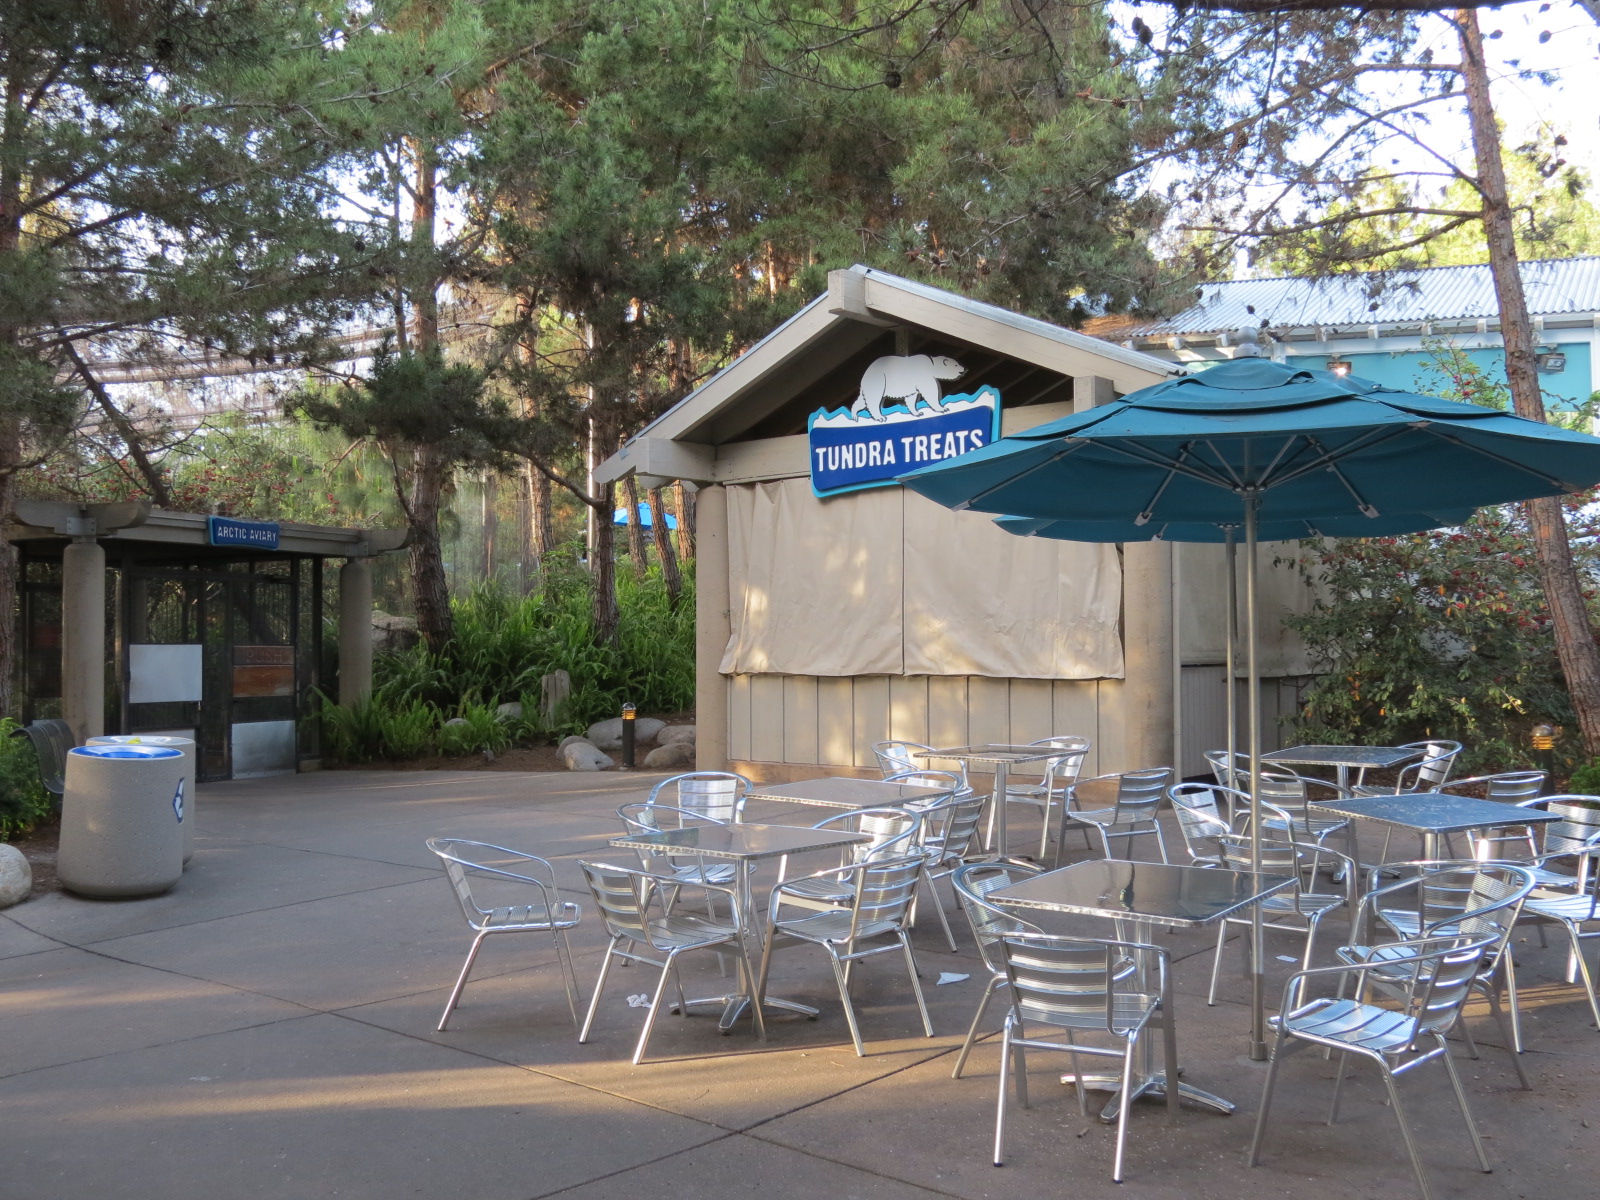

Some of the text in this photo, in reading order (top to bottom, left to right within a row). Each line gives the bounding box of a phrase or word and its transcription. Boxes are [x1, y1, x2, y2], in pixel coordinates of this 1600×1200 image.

[815, 429, 983, 472] TUNDRA TREATS
[217, 526, 277, 542] ARCTIC AVIARY
